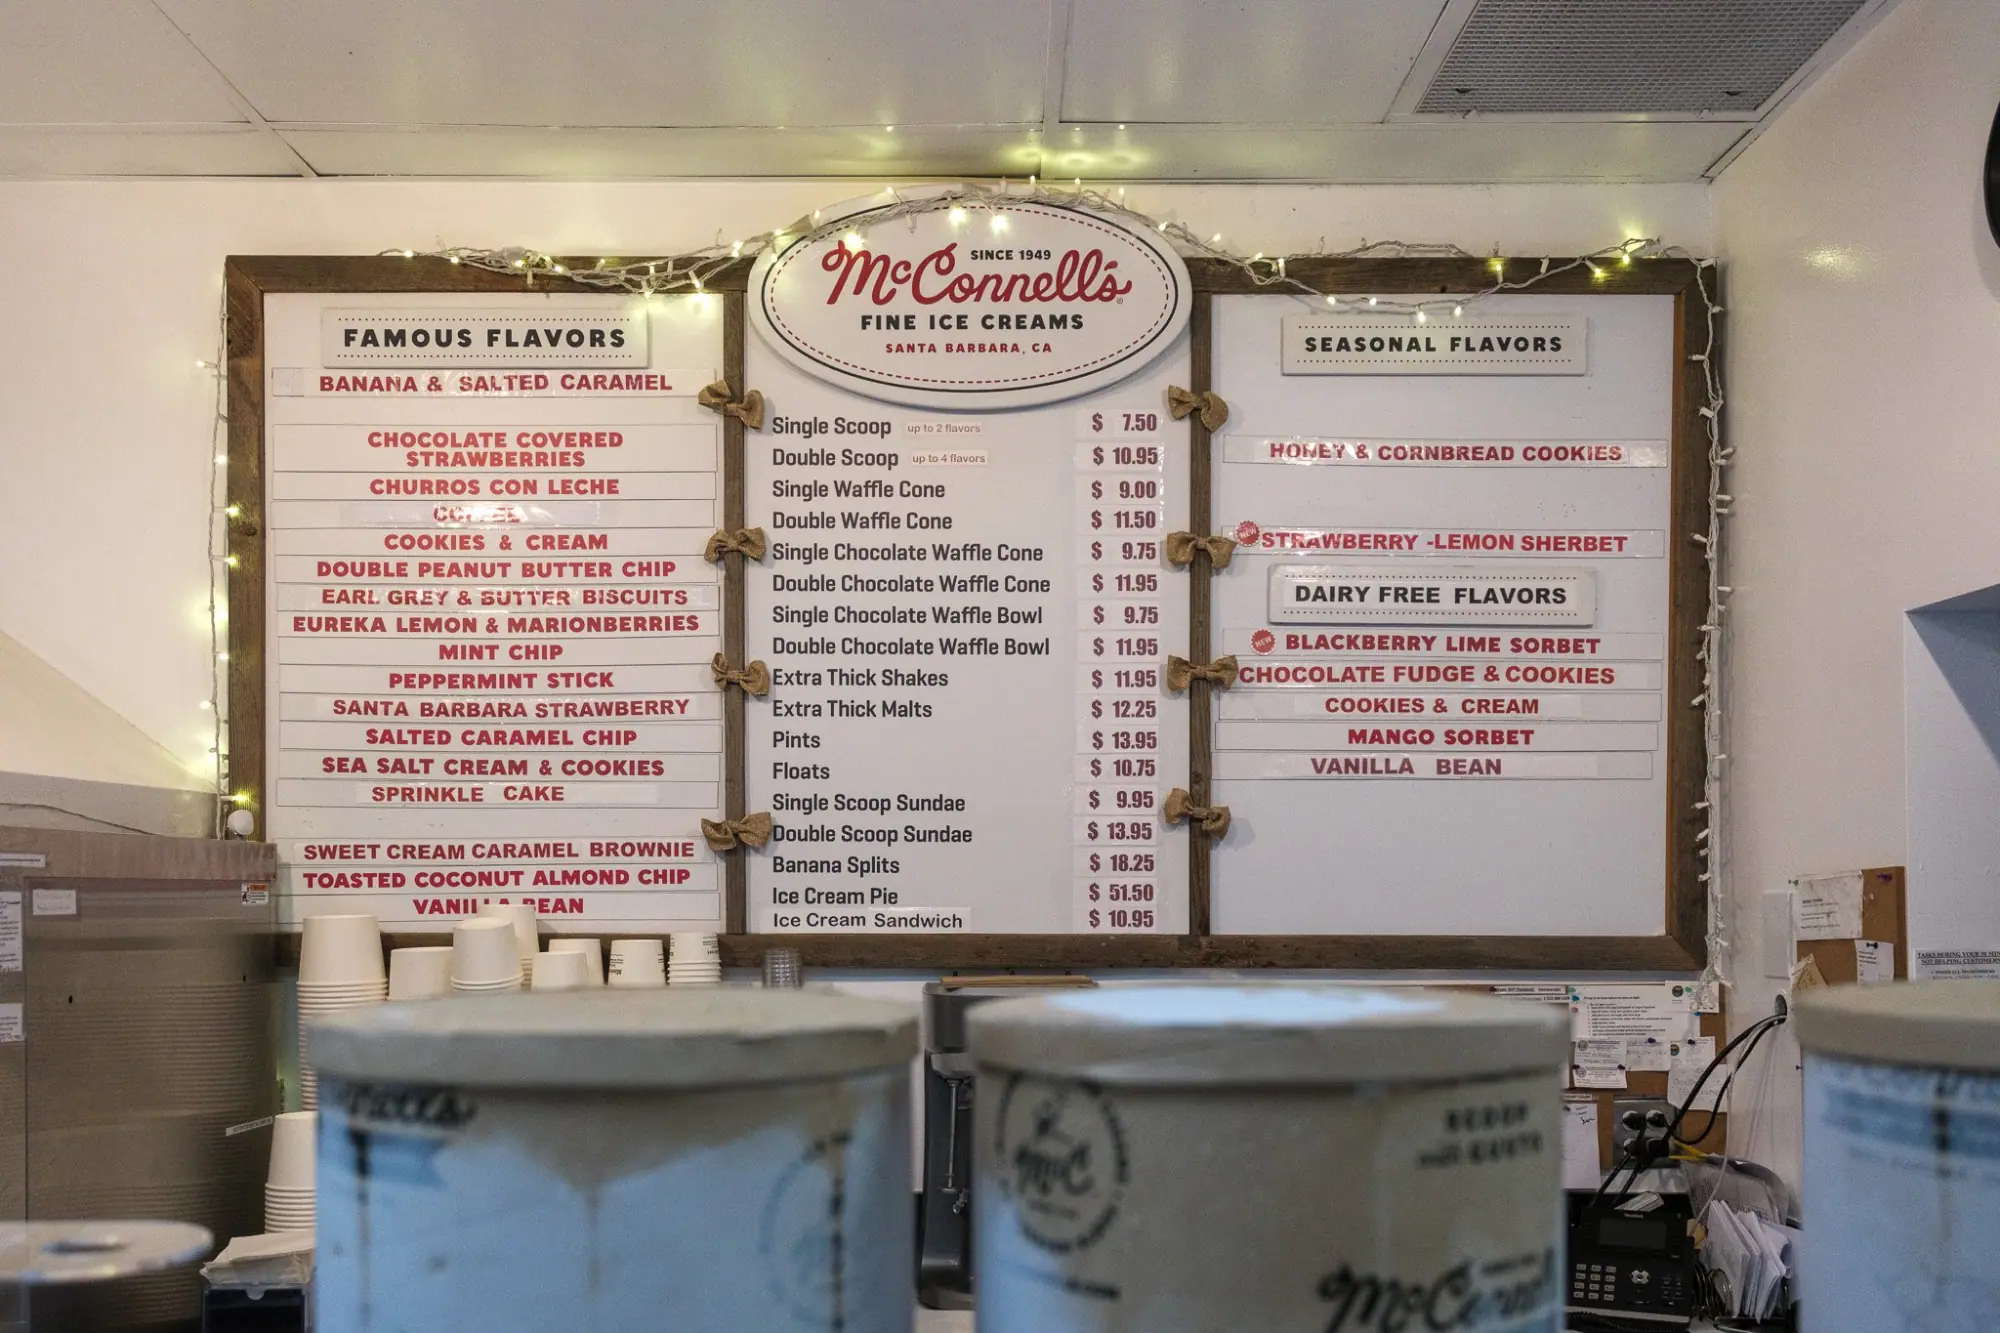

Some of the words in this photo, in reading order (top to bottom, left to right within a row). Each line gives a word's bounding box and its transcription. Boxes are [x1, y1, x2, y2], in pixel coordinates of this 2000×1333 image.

[970, 249, 1014, 261] SINCE
[1018, 249, 1052, 261] 1949
[820, 241, 1133, 306] McConnell's
[861, 314, 916, 331] FINE
[929, 314, 969, 331] ICE
[980, 313, 1084, 331] CREAMS
[344, 328, 473, 348] FAMOUS
[486, 328, 625, 349] FLAVORS
[1305, 336, 1437, 353] SEASONAL
[1450, 336, 1562, 353] FLAVORS
[885, 342, 937, 354] SANTA
[945, 342, 1027, 355] BARBARA,
[1031, 342, 1052, 353] CA
[319, 375, 418, 393] BANANA
[426, 375, 443, 393] &
[459, 374, 549, 392] SALTED
[560, 373, 673, 391] CARAMEL
[771, 416, 829, 439] Single
[833, 416, 892, 440] Scoop
[945, 423, 981, 433] flavors
[1122, 413, 1158, 432] 7.50
[367, 431, 507, 449] CHOCOLATE
[516, 431, 624, 449] COVERED
[406, 450, 585, 468] STRAWBERRIES
[772, 447, 836, 467] Double
[841, 448, 899, 471] Scoop
[949, 453, 986, 463] flavors
[1112, 446, 1158, 465] 10.95
[1270, 442, 1345, 459] HONEY
[1355, 443, 1369, 459] &
[1377, 445, 1515, 461] CORNBREAD
[1522, 445, 1622, 462] COOKIES
[369, 478, 481, 496] CHURROS
[489, 479, 538, 496] CON
[548, 478, 620, 496] LECHE
[772, 479, 829, 502] Single
[833, 479, 894, 498] Waffle
[899, 480, 946, 498] Cone
[1119, 480, 1157, 499] 9.00
[1121, 541, 1157, 561] 9.75
[1261, 531, 1419, 551] STRAWBERRY
[1520, 534, 1629, 553] SHERBET
[772, 542, 829, 565] Single
[834, 542, 927, 561] Chocolate
[931, 543, 992, 562] Waffle
[997, 543, 1044, 562] Cone
[316, 560, 409, 578] DOUBLE
[418, 561, 512, 579] PEANUT
[521, 561, 613, 579] BUTTER
[621, 560, 677, 578] CHIP
[322, 588, 381, 605] EARL
[387, 589, 449, 606] GREY
[456, 590, 473, 606] &
[480, 590, 571, 607] BUTTER
[582, 589, 688, 606] BISCUITS
[1295, 585, 1371, 603] DAIRY
[1378, 586, 1441, 604] FREE
[1454, 587, 1567, 605] FLAVORS
[293, 615, 387, 633] EUREKA
[396, 616, 477, 634] LEMON
[485, 616, 499, 634] &
[507, 614, 700, 634] MARIONBERRIES
[438, 644, 500, 661] MINT
[508, 644, 564, 661] CHIP
[772, 636, 836, 655] Double
[841, 637, 934, 656] Chocolate
[938, 637, 999, 656] Waffle
[1004, 637, 1050, 656] Bowl
[1115, 638, 1158, 656] 11.95
[1286, 634, 1437, 652] BLACKBERRY
[1445, 635, 1501, 653] LIME
[1509, 637, 1601, 655] SORBET
[389, 672, 538, 690] PEPPERMINT
[547, 671, 615, 689] STICK
[772, 668, 822, 687] Extra
[826, 668, 877, 687] Thick
[881, 668, 949, 687] Shakes
[1114, 669, 1157, 688] 11.95
[1237, 665, 1385, 684] CHOCOLATE
[1393, 665, 1475, 683] FUDGE
[1483, 665, 1501, 683] &
[1505, 665, 1615, 685] COOKIES
[332, 699, 410, 717] SANTA
[420, 701, 528, 718] BARBARA
[534, 698, 690, 719] STRAWBERRY
[772, 699, 822, 718] Extra
[826, 699, 877, 718] Thick
[881, 699, 933, 718] Malts
[1111, 699, 1157, 719] 12.25
[1324, 697, 1425, 714] COOKIES
[1432, 697, 1449, 714] &
[1461, 698, 1539, 715] CREAM
[772, 730, 821, 749] Pints
[1111, 731, 1157, 750] 13.95
[1347, 728, 1436, 746] MANGO
[1443, 729, 1535, 746] SORBET
[321, 756, 368, 774] SEA
[376, 757, 435, 775] SALT
[443, 758, 528, 776] CREAM
[538, 759, 553, 777] &
[560, 759, 665, 777] COOKIES
[772, 761, 830, 780] Floats
[1113, 758, 1156, 777] 10.75
[1311, 757, 1415, 775] VANILLA
[1436, 758, 1502, 776] BEAN
[371, 786, 484, 803] SPRINKLE
[503, 785, 565, 802] CAKE
[1116, 790, 1154, 809] 9.95
[772, 792, 829, 816] Single
[833, 793, 892, 816] Scoop
[896, 793, 966, 812] Sundae
[303, 843, 381, 861] SWEET
[386, 844, 465, 860] CREAM
[471, 842, 580, 859] CARAMEL
[589, 841, 695, 858] BROWNIE
[772, 855, 842, 874] Banana
[847, 855, 900, 878] Splits
[1109, 853, 1155, 872] 18.25
[302, 872, 407, 889] TOASTED
[414, 870, 525, 889] COCONUT
[532, 869, 630, 886] ALMOND
[637, 868, 691, 886] CHIP
[772, 887, 799, 905] Ice
[804, 887, 865, 905] Cream
[870, 887, 898, 905] Pie
[1109, 883, 1154, 902] 51.50
[773, 912, 801, 928] Ice
[806, 912, 866, 928] Cream
[874, 912, 963, 929] Sandwich
[1108, 909, 1154, 928] 10.95
